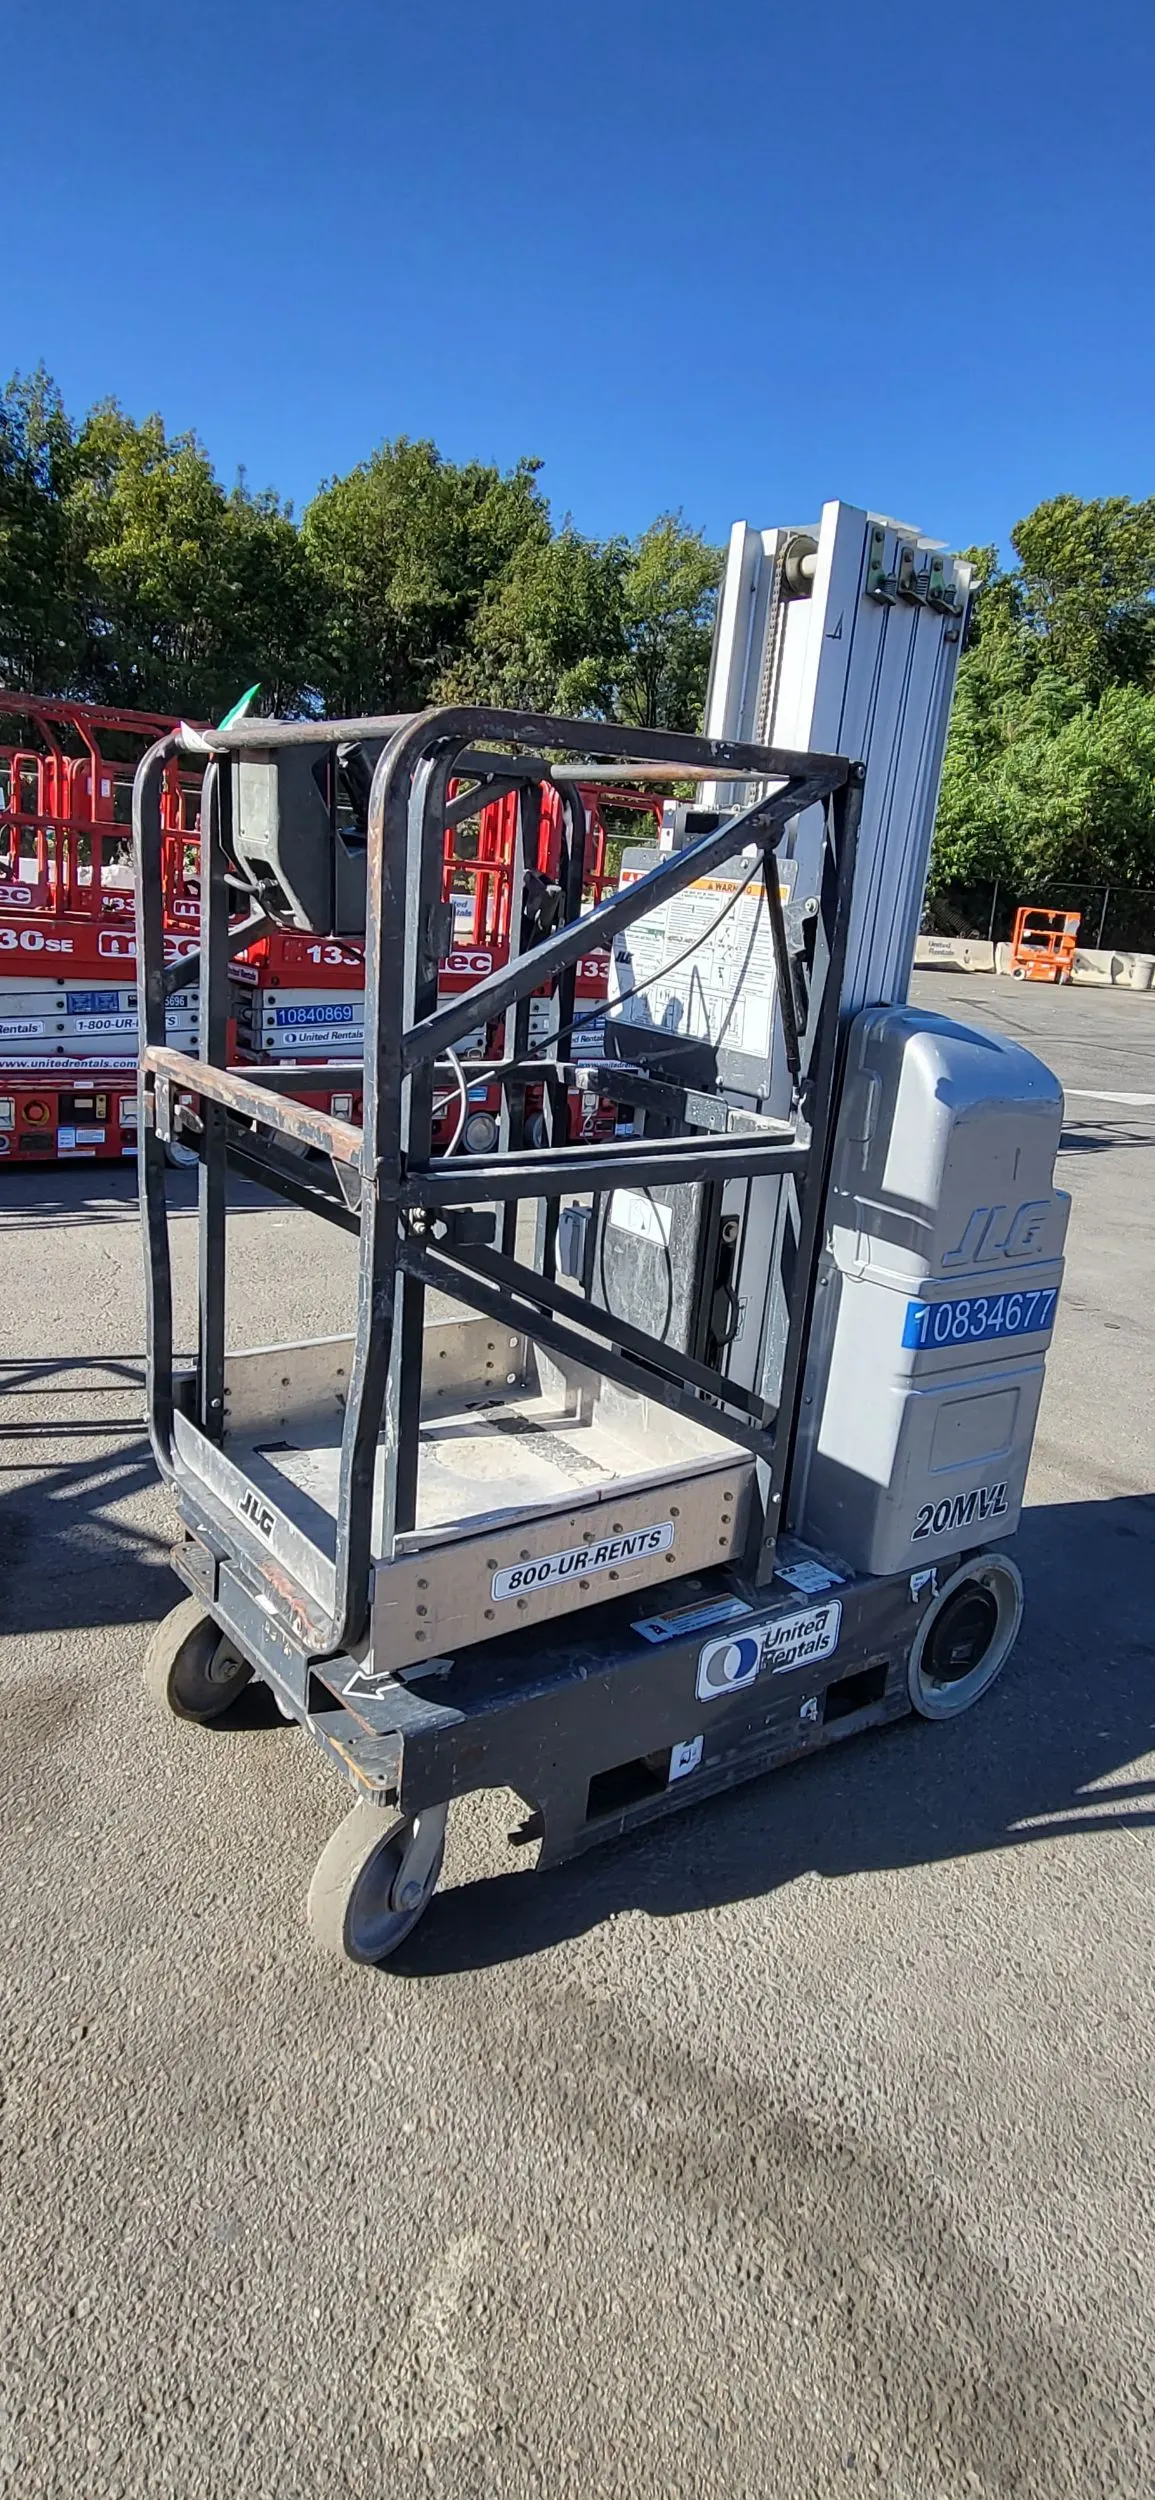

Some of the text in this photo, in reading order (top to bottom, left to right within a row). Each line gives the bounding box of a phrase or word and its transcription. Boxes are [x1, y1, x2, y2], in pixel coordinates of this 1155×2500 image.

[0, 886, 30, 904] ec
[715, 882, 752, 894] WARNG
[0, 929, 74, 953] 30SE
[306, 944, 361, 966] 133
[440, 954, 491, 972] ec
[279, 1006, 352, 1024] 10840869
[298, 1030, 364, 1042] United Rentals
[941, 1199, 1051, 1269] JLG
[913, 1288, 1057, 1344] 10834677
[238, 1489, 275, 1540] JLG
[910, 1481, 1009, 1542] 20MVL
[507, 1530, 661, 1591] 800-UR-RENTS
[764, 1609, 830, 1650] United
